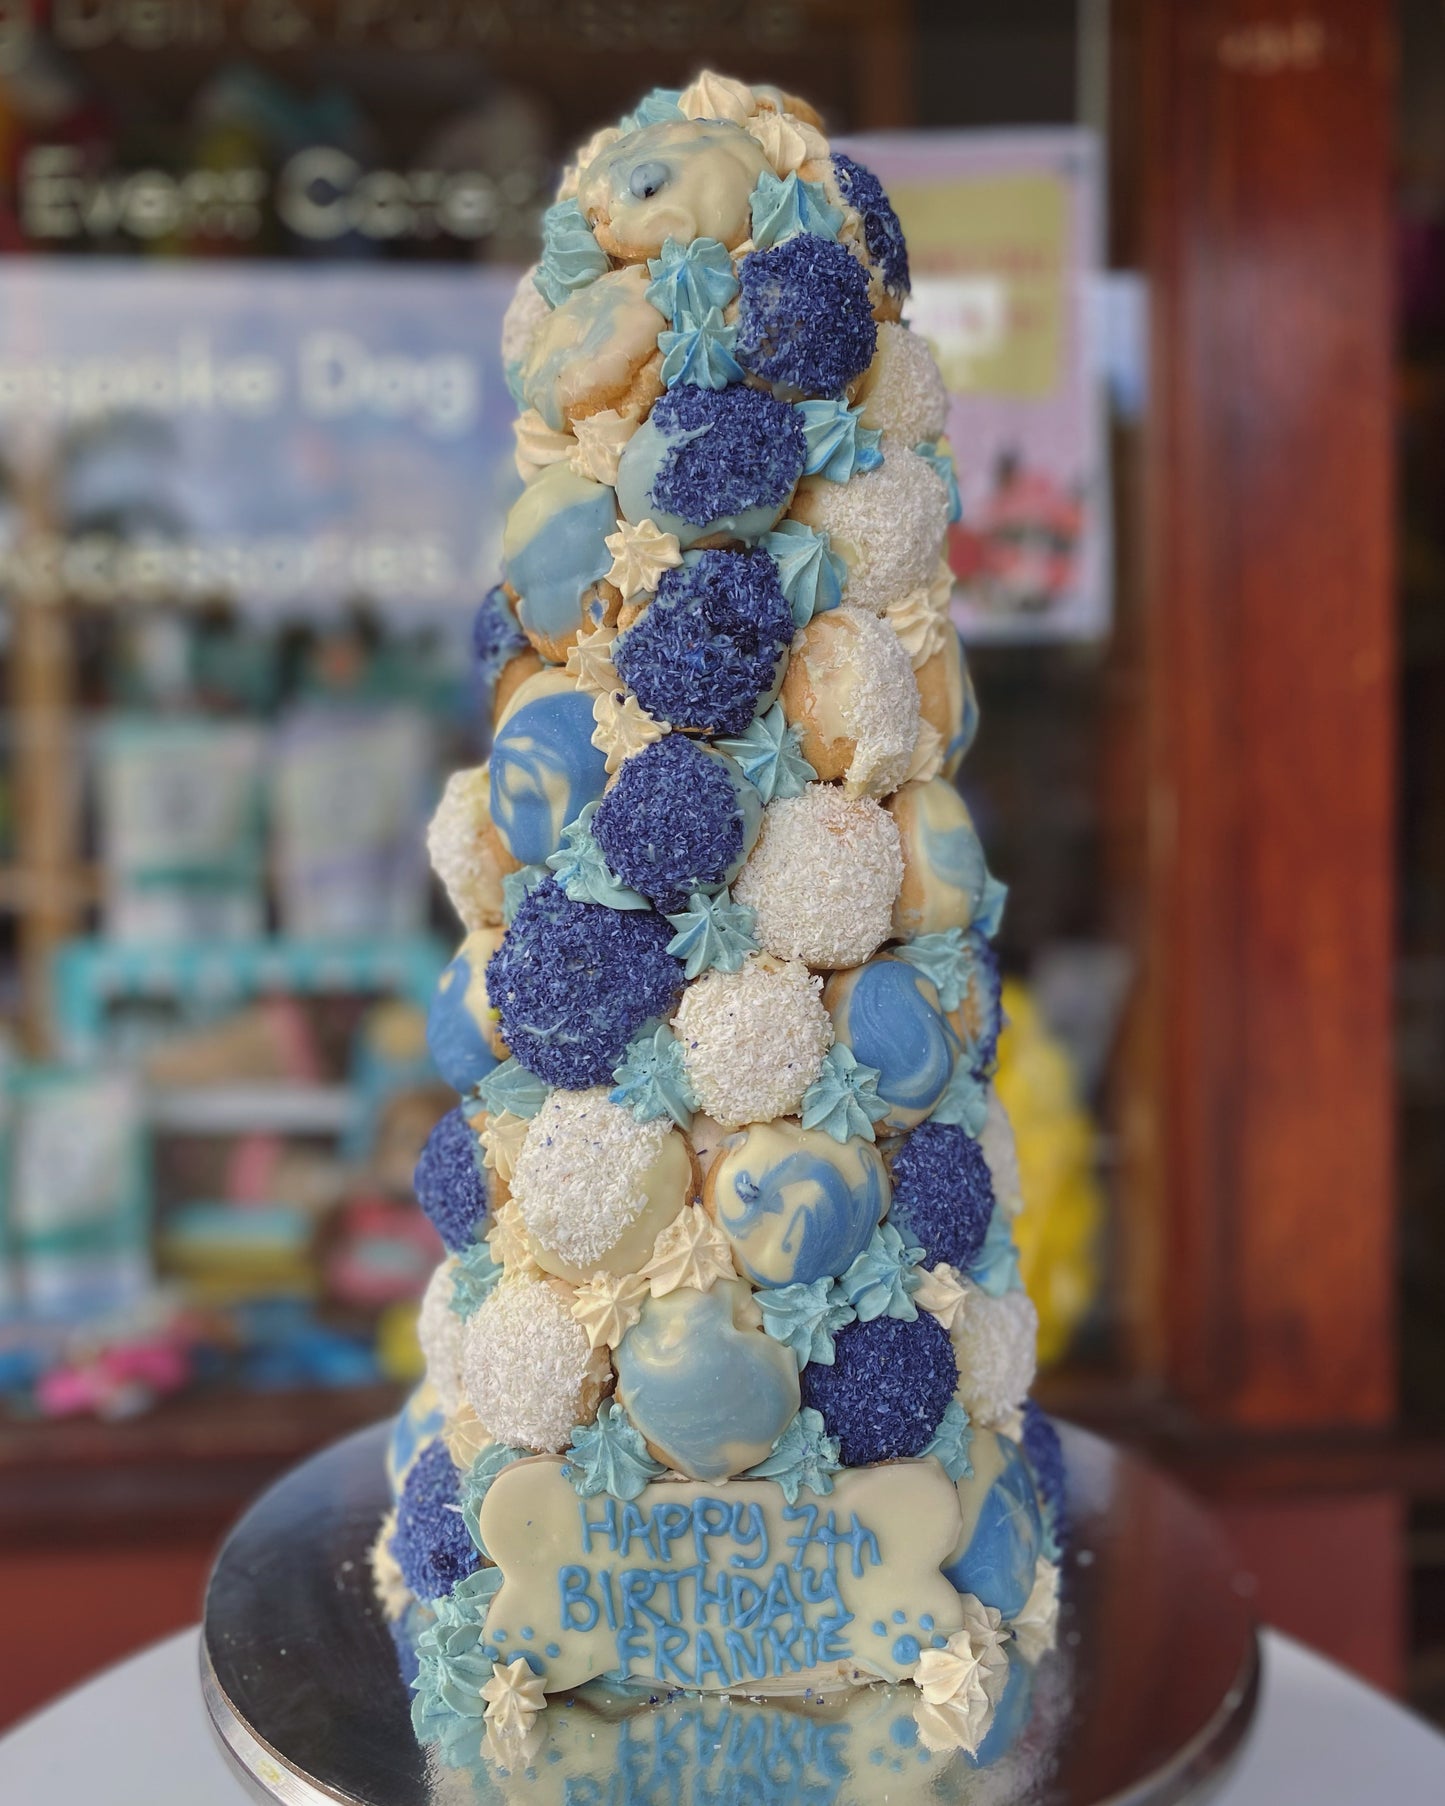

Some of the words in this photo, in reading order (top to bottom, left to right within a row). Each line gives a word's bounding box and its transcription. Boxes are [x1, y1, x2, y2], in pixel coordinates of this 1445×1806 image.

[20, 146, 266, 239] Event
[303, 331, 478, 438] Dog
[579, 1497, 768, 1570] HAPPY
[781, 1503, 883, 1577] 7th
[558, 1562, 854, 1634] BIRTHDAY
[617, 1618, 854, 1687] FRANKIE
